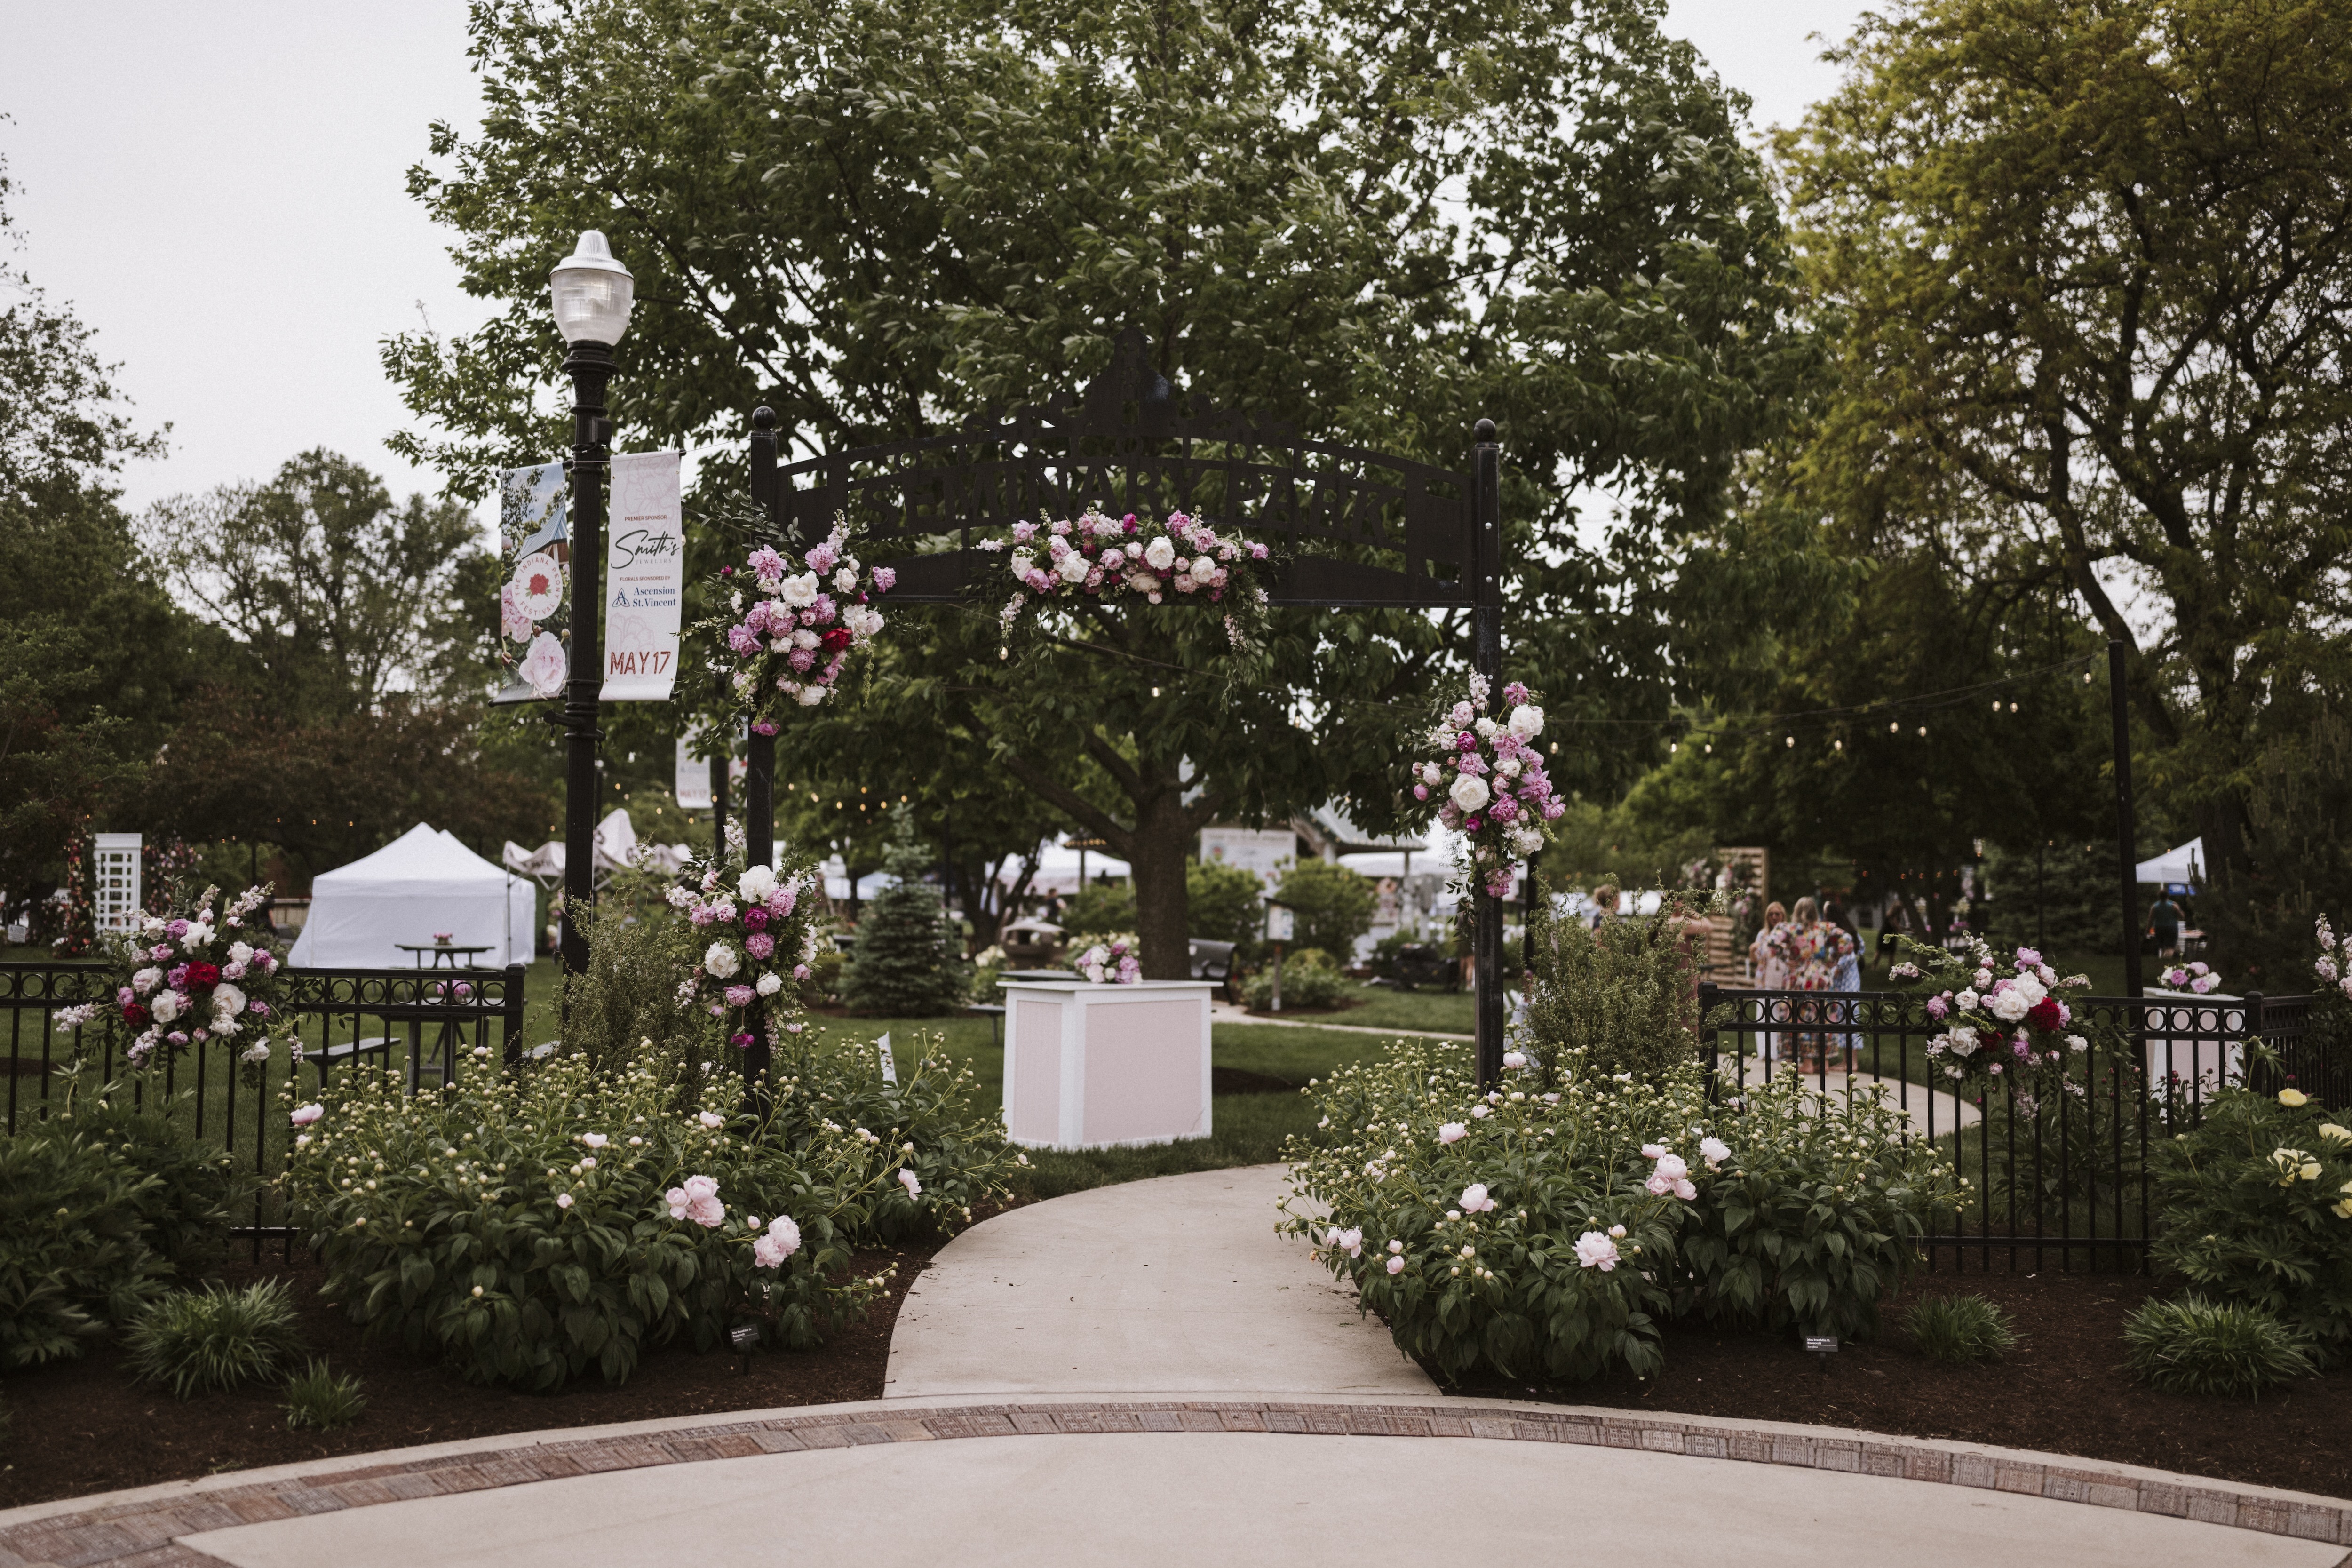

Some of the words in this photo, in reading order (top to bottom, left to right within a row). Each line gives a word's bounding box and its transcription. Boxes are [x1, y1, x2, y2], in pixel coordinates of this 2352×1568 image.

[862, 465, 1204, 527] SEMINARY
[1226, 471, 1394, 538] PARK
[611, 529, 680, 569] Smith's
[520, 557, 549, 573] INDIANA
[552, 567, 561, 599] PEONY
[633, 586, 675, 596] Ascension
[520, 601, 555, 616] FESTIVAL
[645, 598, 676, 607] Vincent
[610, 652, 650, 675] MAY
[653, 651, 671, 674] 17
